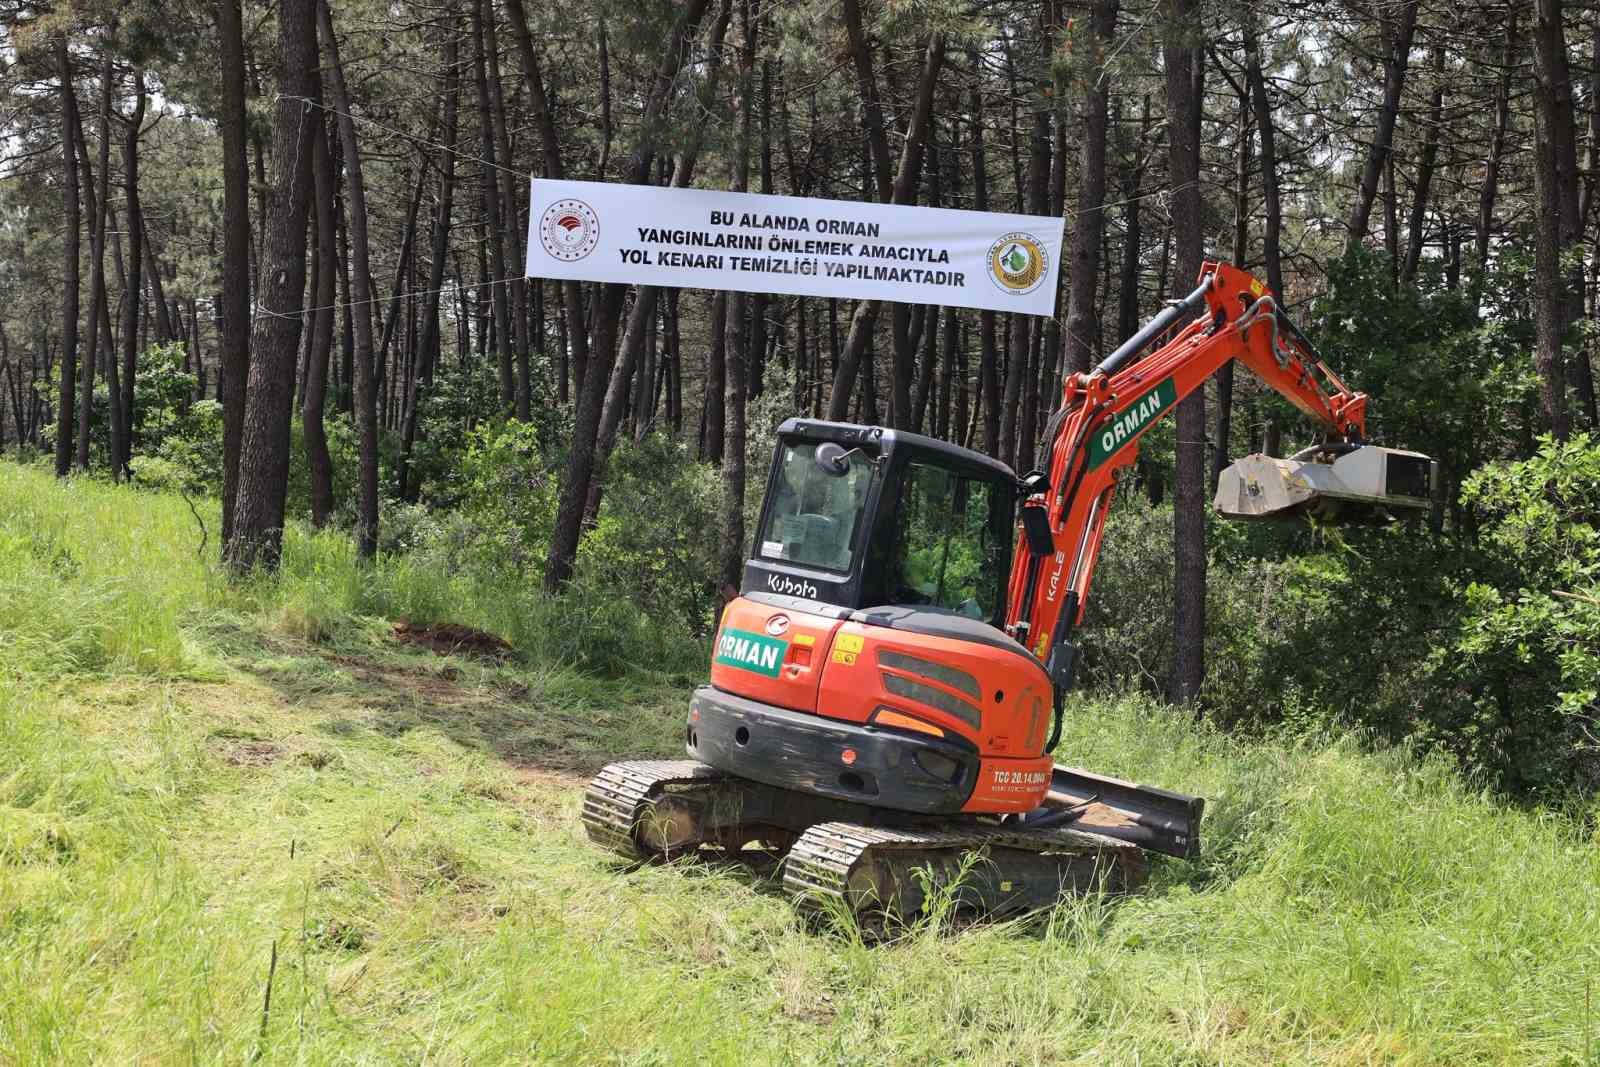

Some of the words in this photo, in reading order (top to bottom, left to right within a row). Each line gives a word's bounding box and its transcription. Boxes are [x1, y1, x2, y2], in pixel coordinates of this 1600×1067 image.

[710, 210, 734, 226] BU
[739, 213, 810, 232] ALANDA
[815, 218, 879, 238] ORMAN
[638, 227, 762, 251] YANGINLARINI
[768, 234, 854, 257] ÖNLEMEK
[858, 244, 949, 264] AMACIYLA
[619, 248, 652, 264] YOL
[657, 251, 723, 270] KENARI
[729, 255, 818, 276] TEMİZLİĞİ
[824, 261, 965, 287] YAPILMAKTADIR
[1102, 390, 1161, 452] ORMAN
[767, 573, 817, 599] Kubota
[718, 635, 780, 670] ORMAN
